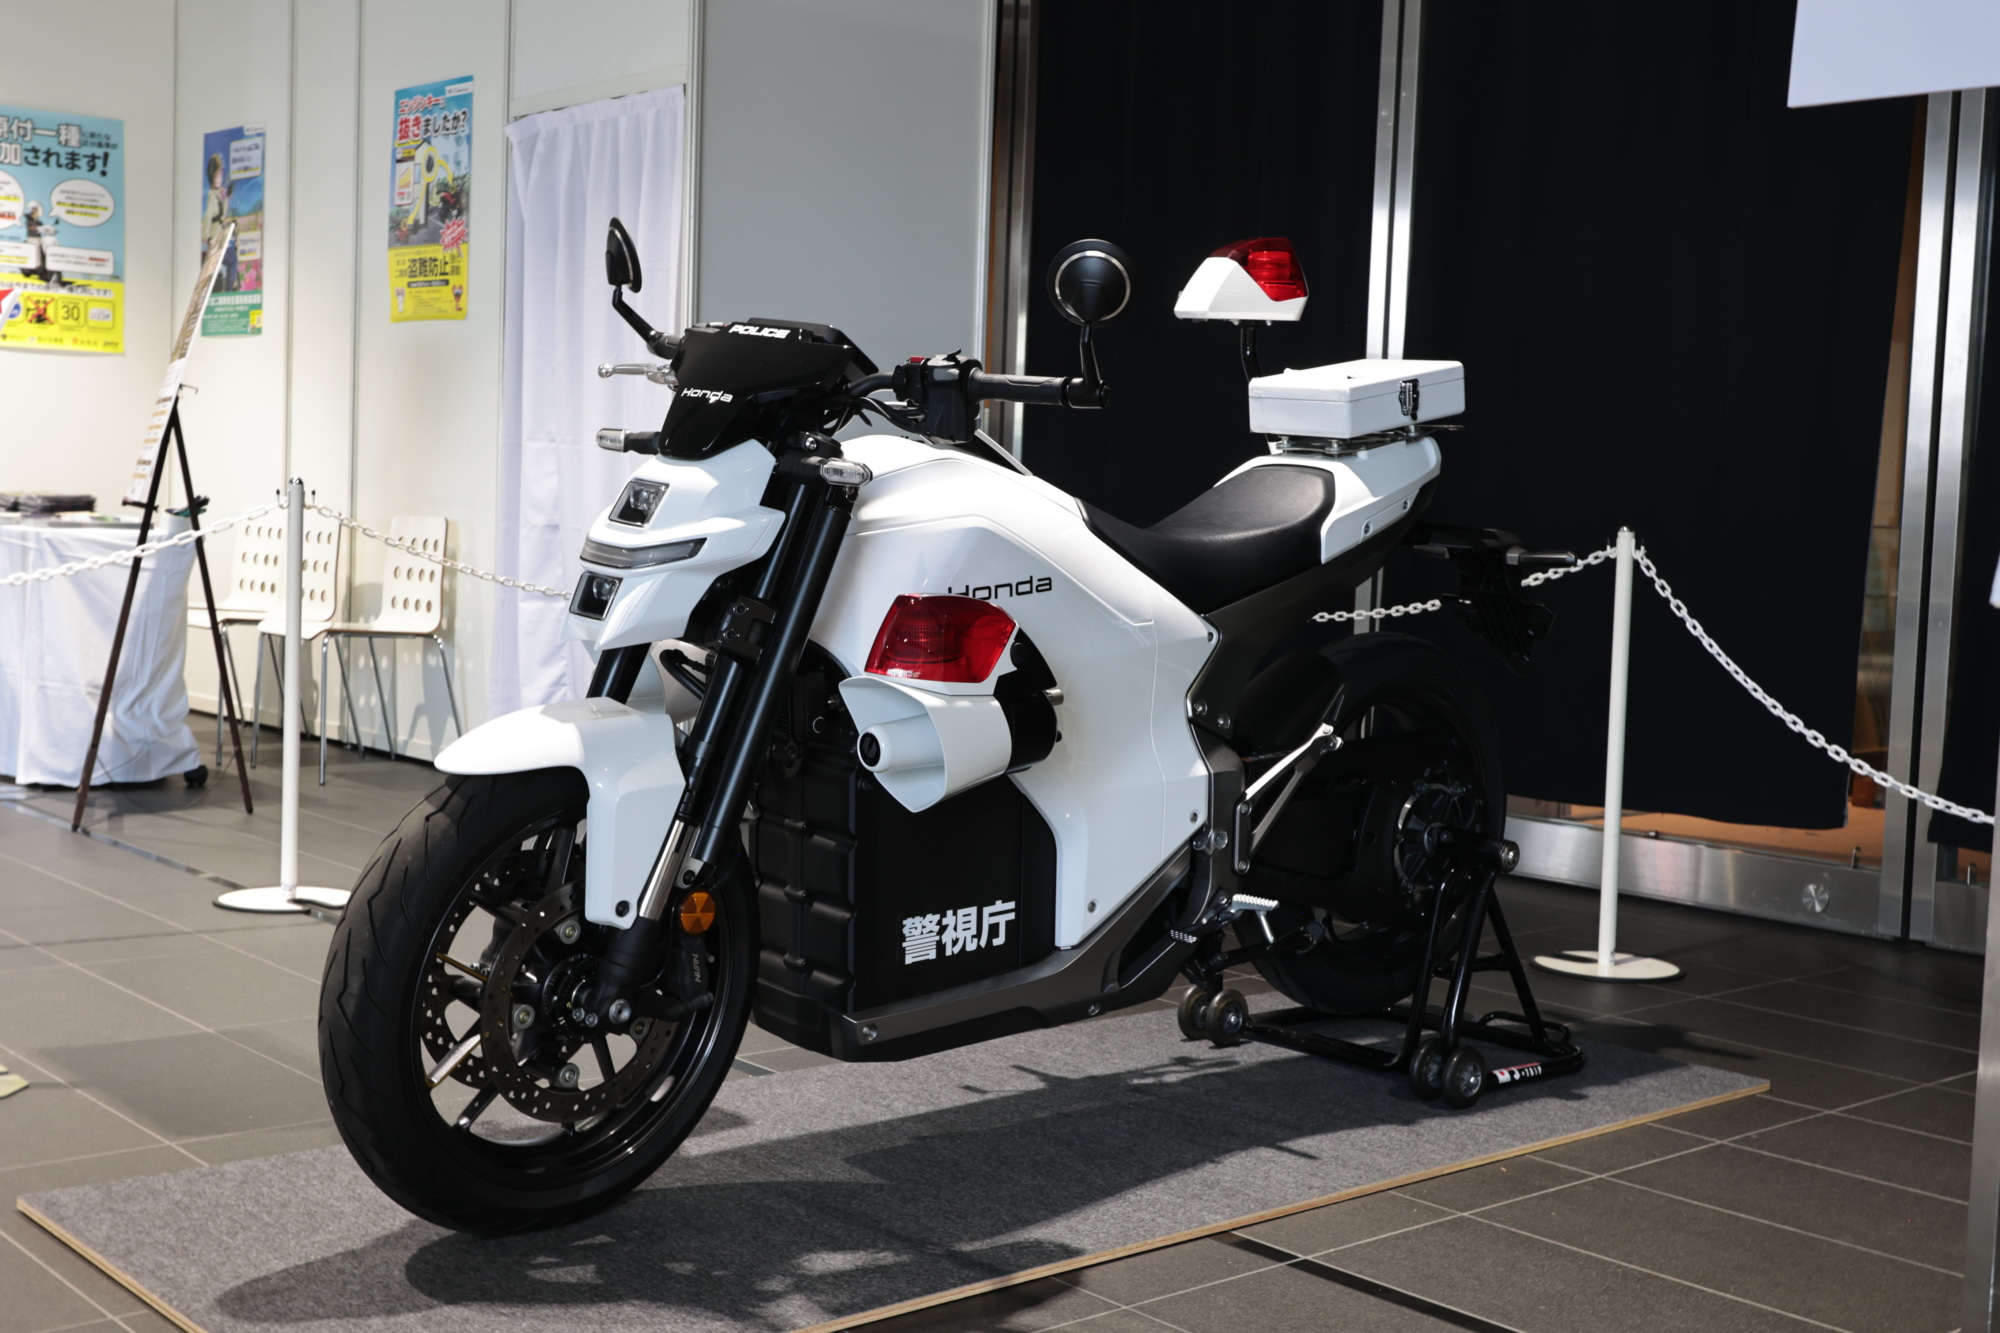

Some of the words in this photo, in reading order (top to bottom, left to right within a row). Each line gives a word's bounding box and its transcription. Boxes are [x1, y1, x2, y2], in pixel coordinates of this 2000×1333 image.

[61, 304, 80, 321] 30
[728, 324, 791, 339] POLICE
[680, 387, 734, 403] Honda
[902, 900, 1016, 965] 警視庁
